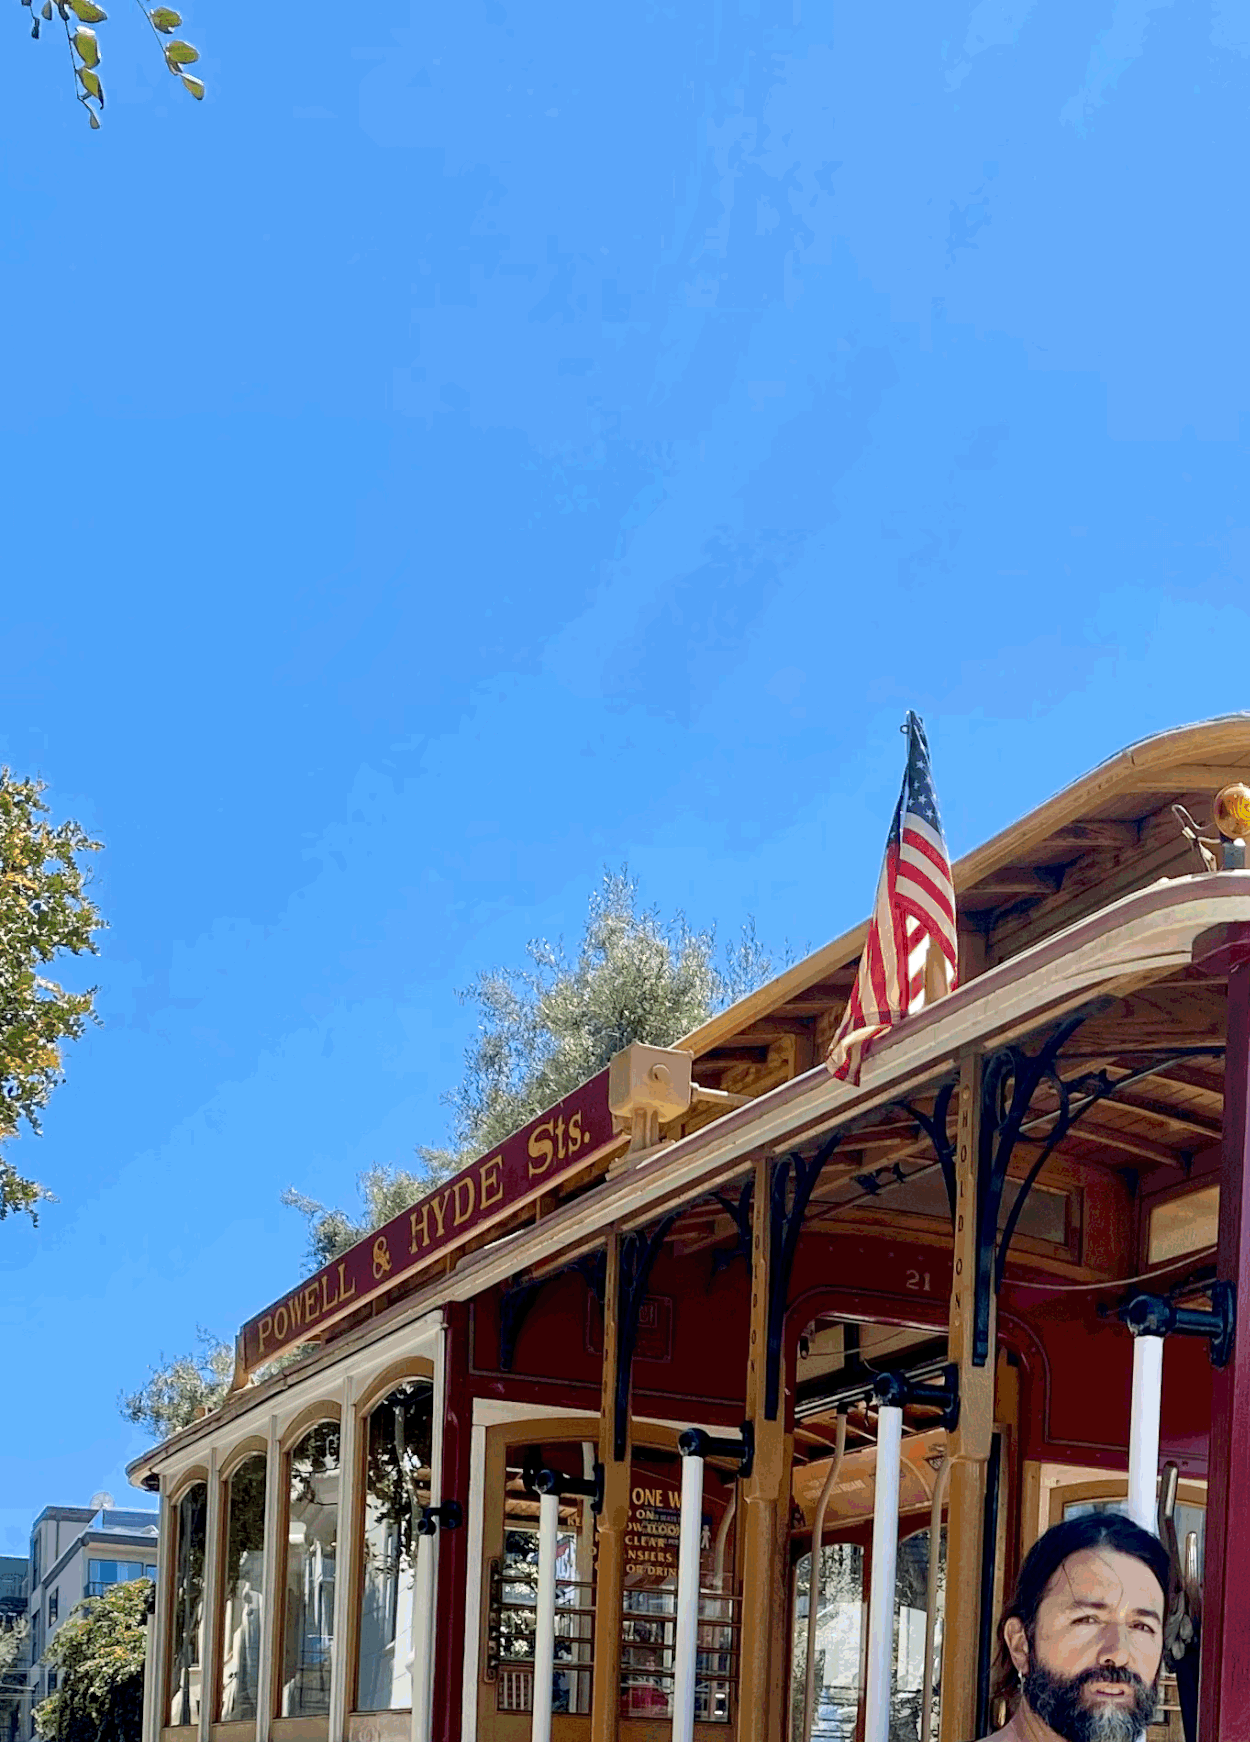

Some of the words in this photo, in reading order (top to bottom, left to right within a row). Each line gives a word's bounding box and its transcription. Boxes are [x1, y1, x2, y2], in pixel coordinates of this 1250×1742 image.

[257, 1263, 355, 1353] POWELL
[372, 1235, 392, 1279] &
[408, 1154, 504, 1254] HYDE
[527, 1110, 590, 1177] Sts.
[905, 1269, 931, 1291] 21
[632, 1487, 664, 1507] ONE
[625, 1535, 665, 1548] CLEAR
[646, 1566, 678, 1577] DRIN
